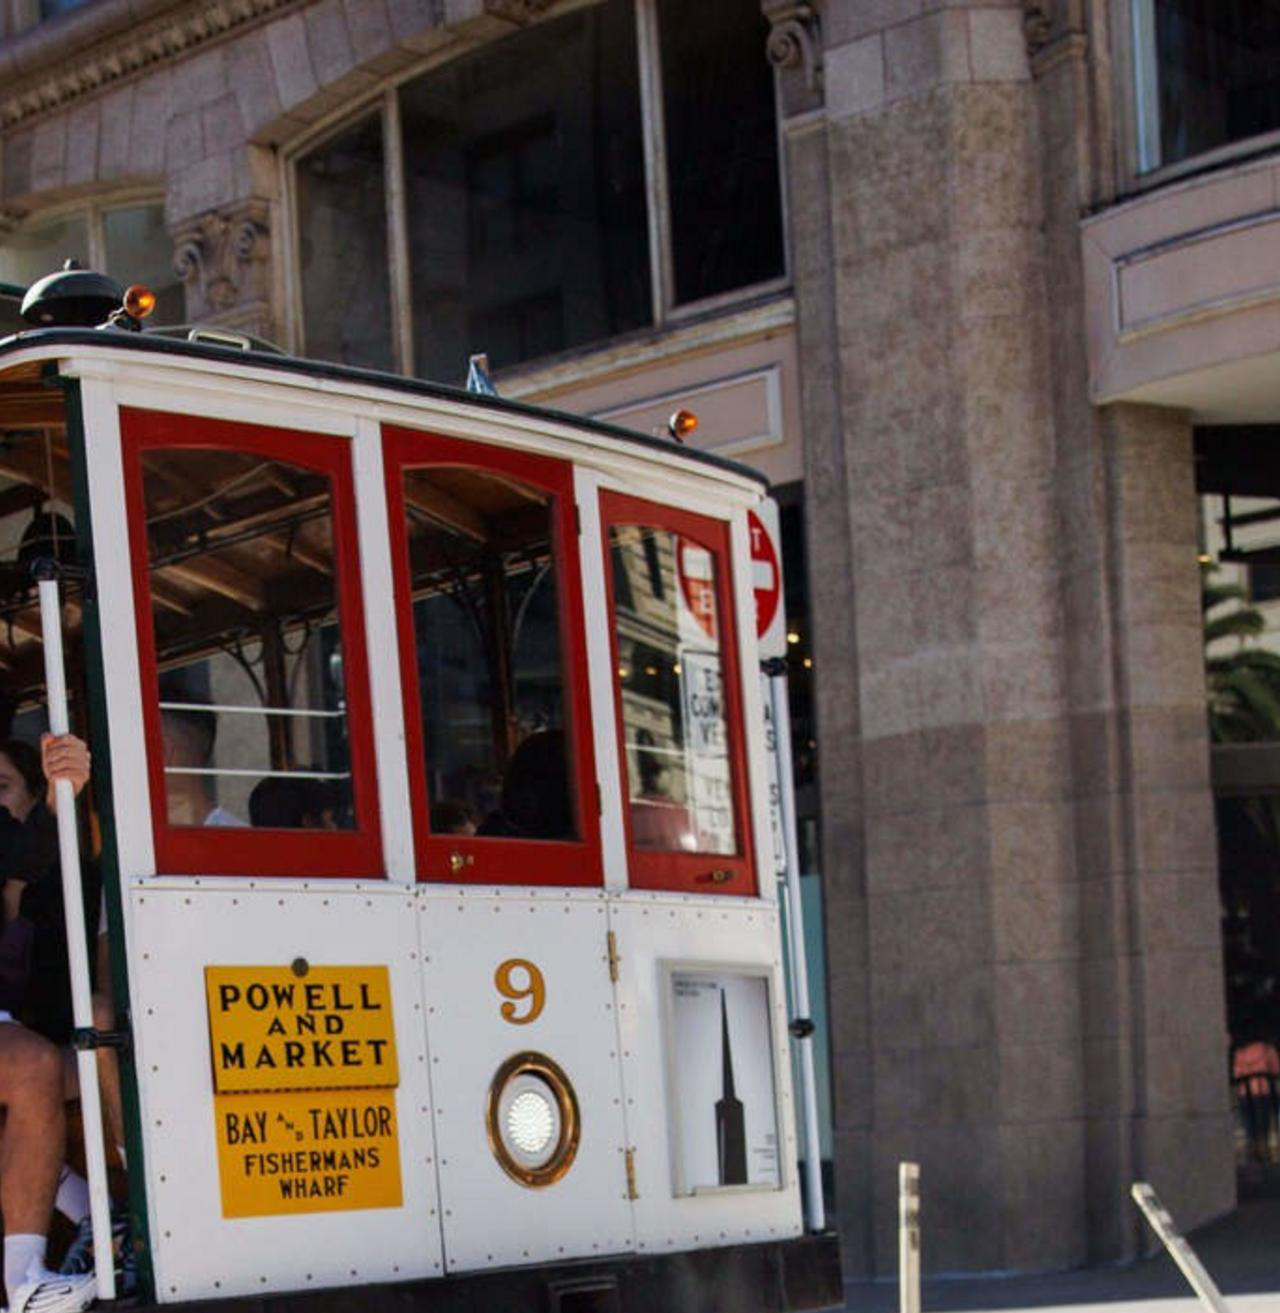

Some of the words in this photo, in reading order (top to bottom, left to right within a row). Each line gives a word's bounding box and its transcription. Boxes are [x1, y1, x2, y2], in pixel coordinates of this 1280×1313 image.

[220, 983, 381, 1012] POWELL
[494, 958, 546, 1026] 9
[267, 1012, 345, 1036] AND
[220, 1038, 387, 1070] MARKET
[225, 1110, 268, 1146] BAY
[276, 1112, 304, 1142] AND
[308, 1105, 392, 1141] TAYLOR
[244, 1147, 381, 1176] FISHERMANS
[279, 1174, 350, 1200] WHARF
